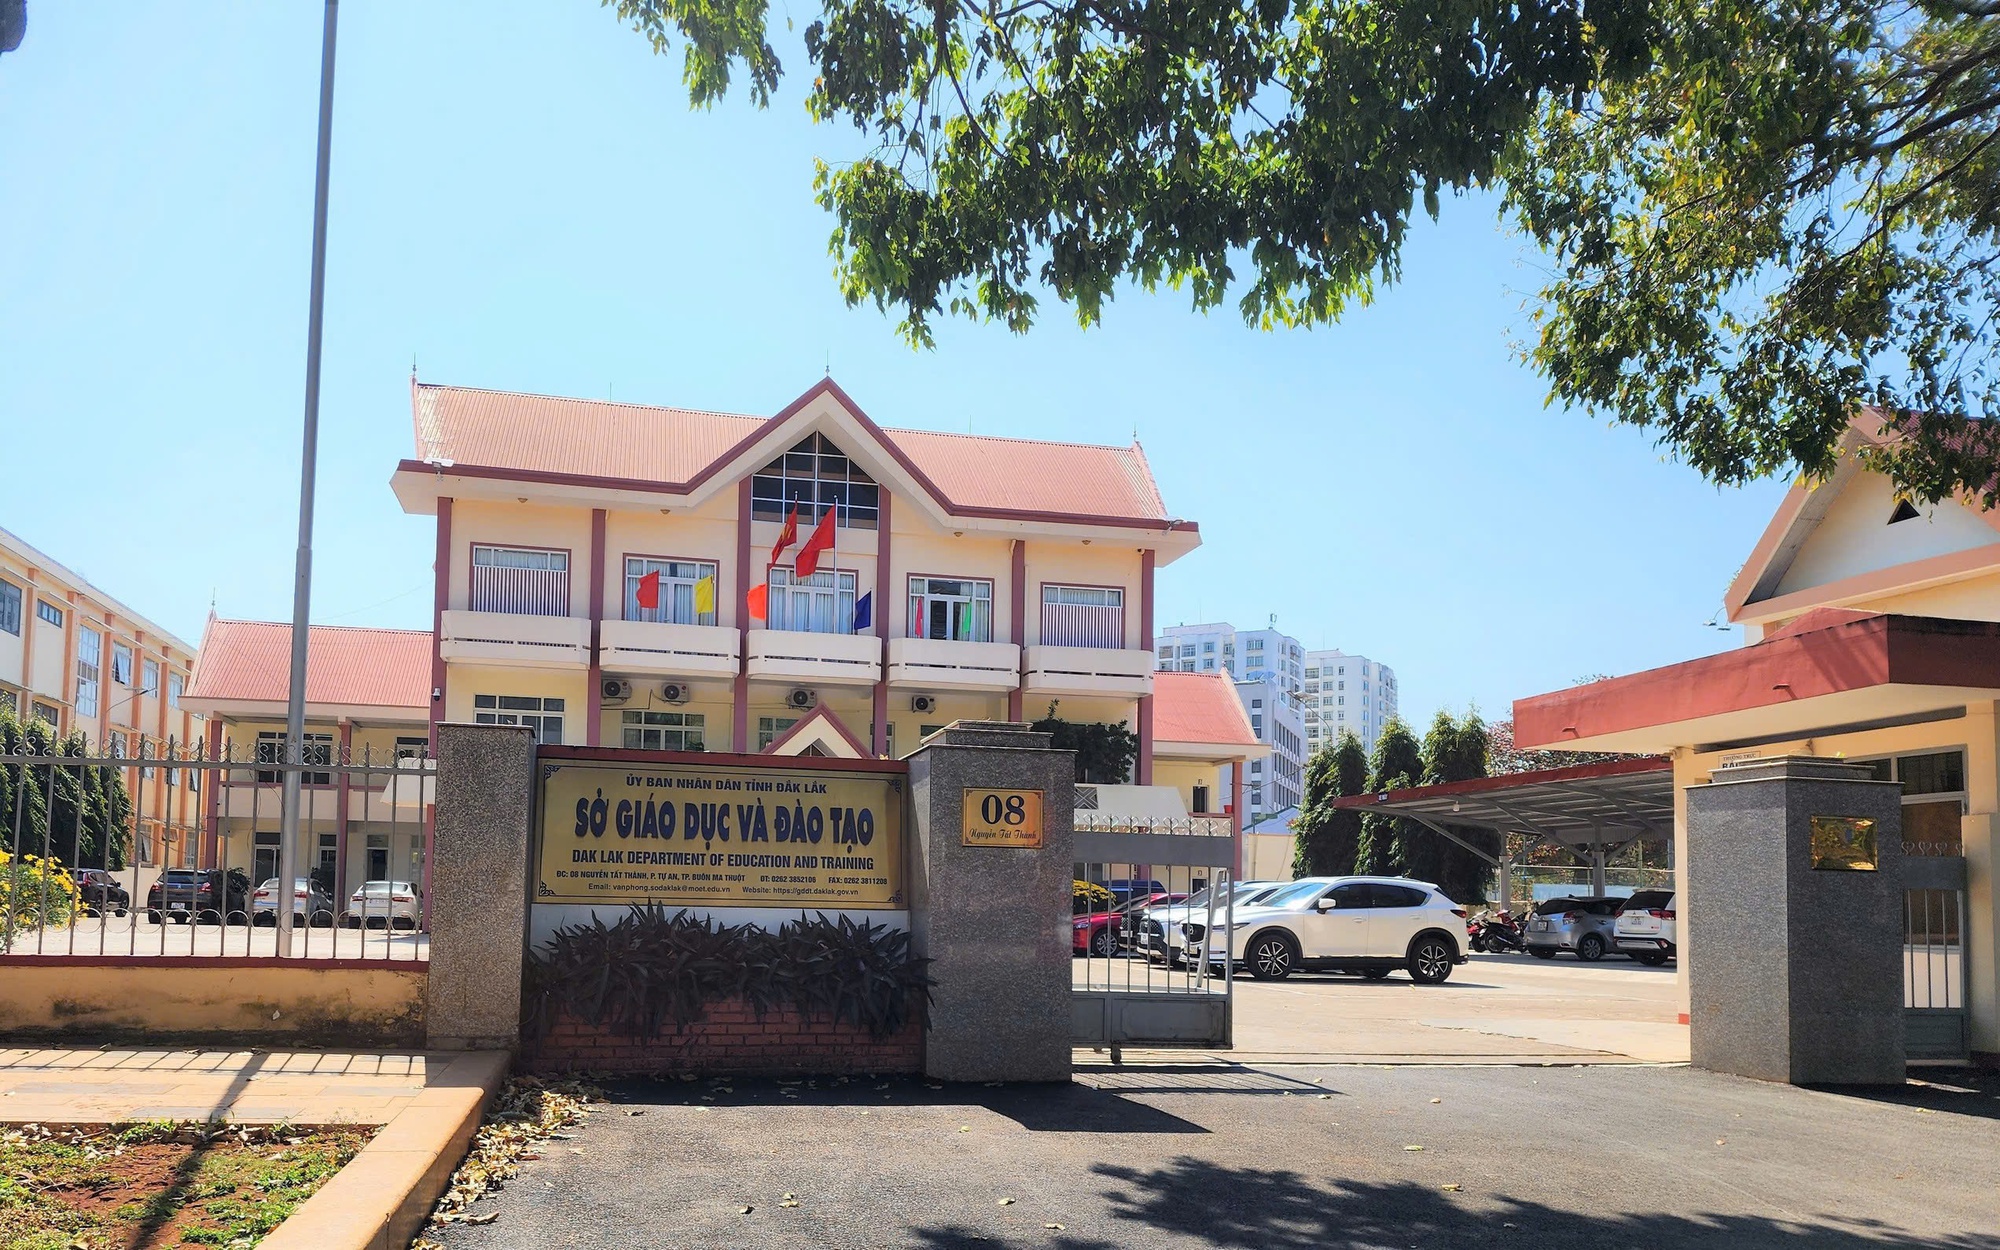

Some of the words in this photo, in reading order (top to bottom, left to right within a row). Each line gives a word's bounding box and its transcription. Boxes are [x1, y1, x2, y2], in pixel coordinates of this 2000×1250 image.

[626, 773, 642, 786] ỦY
[646, 777, 673, 787] BAN
[676, 777, 712, 789] NHÂN
[715, 779, 741, 790] DÂN
[745, 779, 773, 792] TỈNH
[776, 779, 801, 793] ĐẮK
[804, 781, 827, 794] LẮK
[981, 794, 1025, 825] 08
[575, 787, 609, 838] SỞ
[616, 792, 676, 840] GIÁO
[684, 802, 730, 850] DỤC
[737, 797, 769, 843] VÀ
[774, 799, 824, 844] ĐÀO
[830, 807, 874, 854] TẠO
[572, 850, 597, 863] DAK
[600, 851, 624, 864] LAK
[627, 852, 706, 866] DEPARTMENT
[709, 853, 724, 866] OF
[727, 854, 791, 868] EDUCATION
[794, 856, 818, 869] AND
[821, 856, 874, 870] TRAINING
[650, 872, 656, 880] P.
[681, 873, 690, 881] TP.
[692, 873, 710, 881] BUÔN
[725, 874, 746, 882] THUỘT
[772, 875, 788, 883] 0262
[828, 876, 843, 884] FAX:
[613, 884, 731, 893] vanphong.sodaklak@moet.edu.vn
[742, 886, 771, 894] Website:
